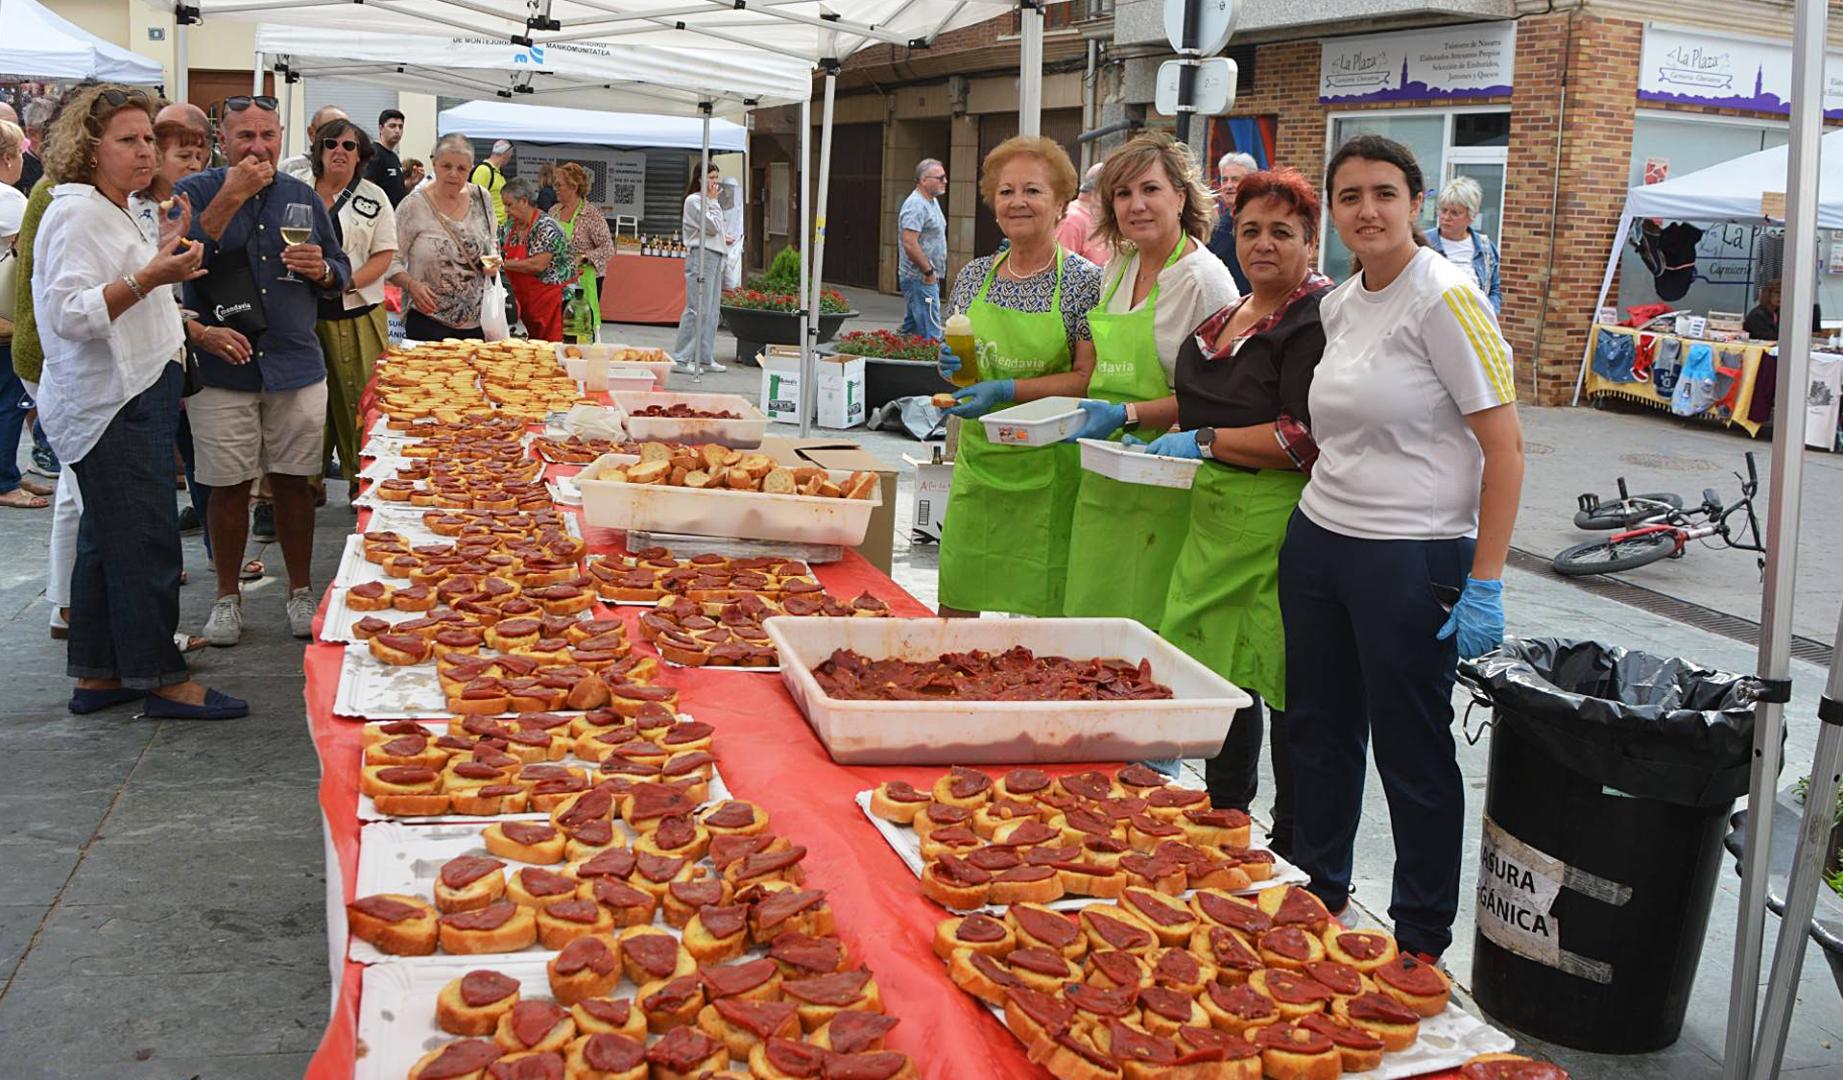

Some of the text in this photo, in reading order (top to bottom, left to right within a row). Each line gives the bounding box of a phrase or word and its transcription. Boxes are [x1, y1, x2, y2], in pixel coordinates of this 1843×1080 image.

[1340, 51, 1376, 70] La Plaza
[1678, 47, 1718, 69] La Plaza
[1722, 223, 1743, 249] La
[1477, 885, 1550, 937] GÁNICA
